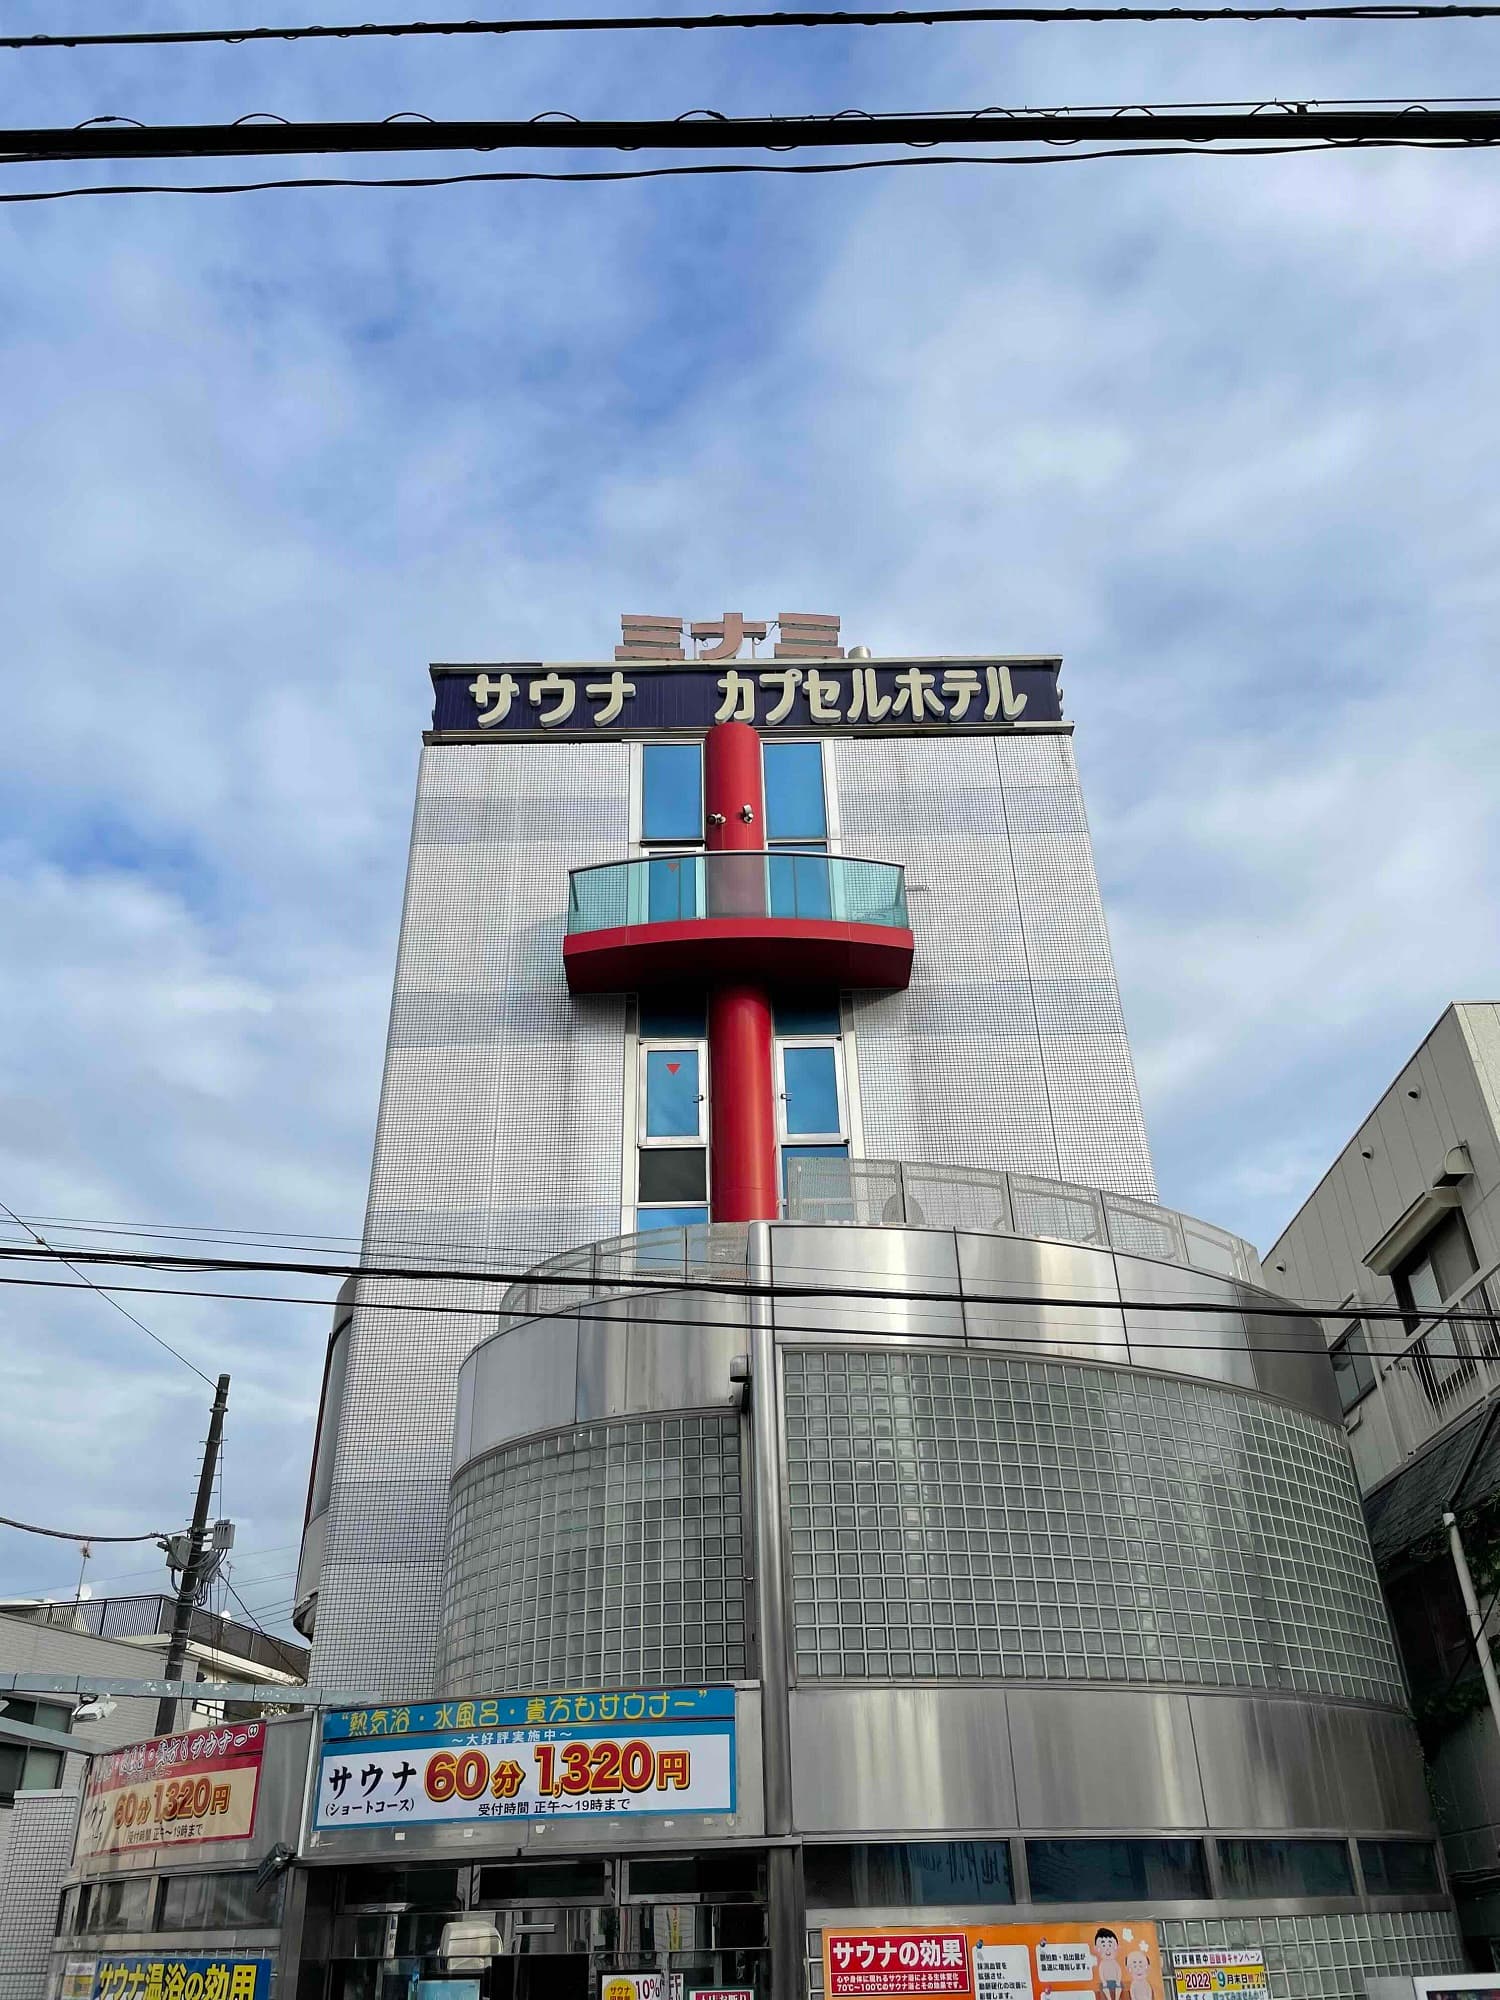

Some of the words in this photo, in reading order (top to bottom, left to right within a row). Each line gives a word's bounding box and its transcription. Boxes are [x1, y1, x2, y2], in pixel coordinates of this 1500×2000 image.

[615, 612, 844, 661] ミナミ
[469, 671, 636, 729] サウナ
[714, 666, 1027, 726] カプセルホテル
[329, 1762, 417, 1800] サウナ
[833, 1940, 963, 1969] サウナの効果
